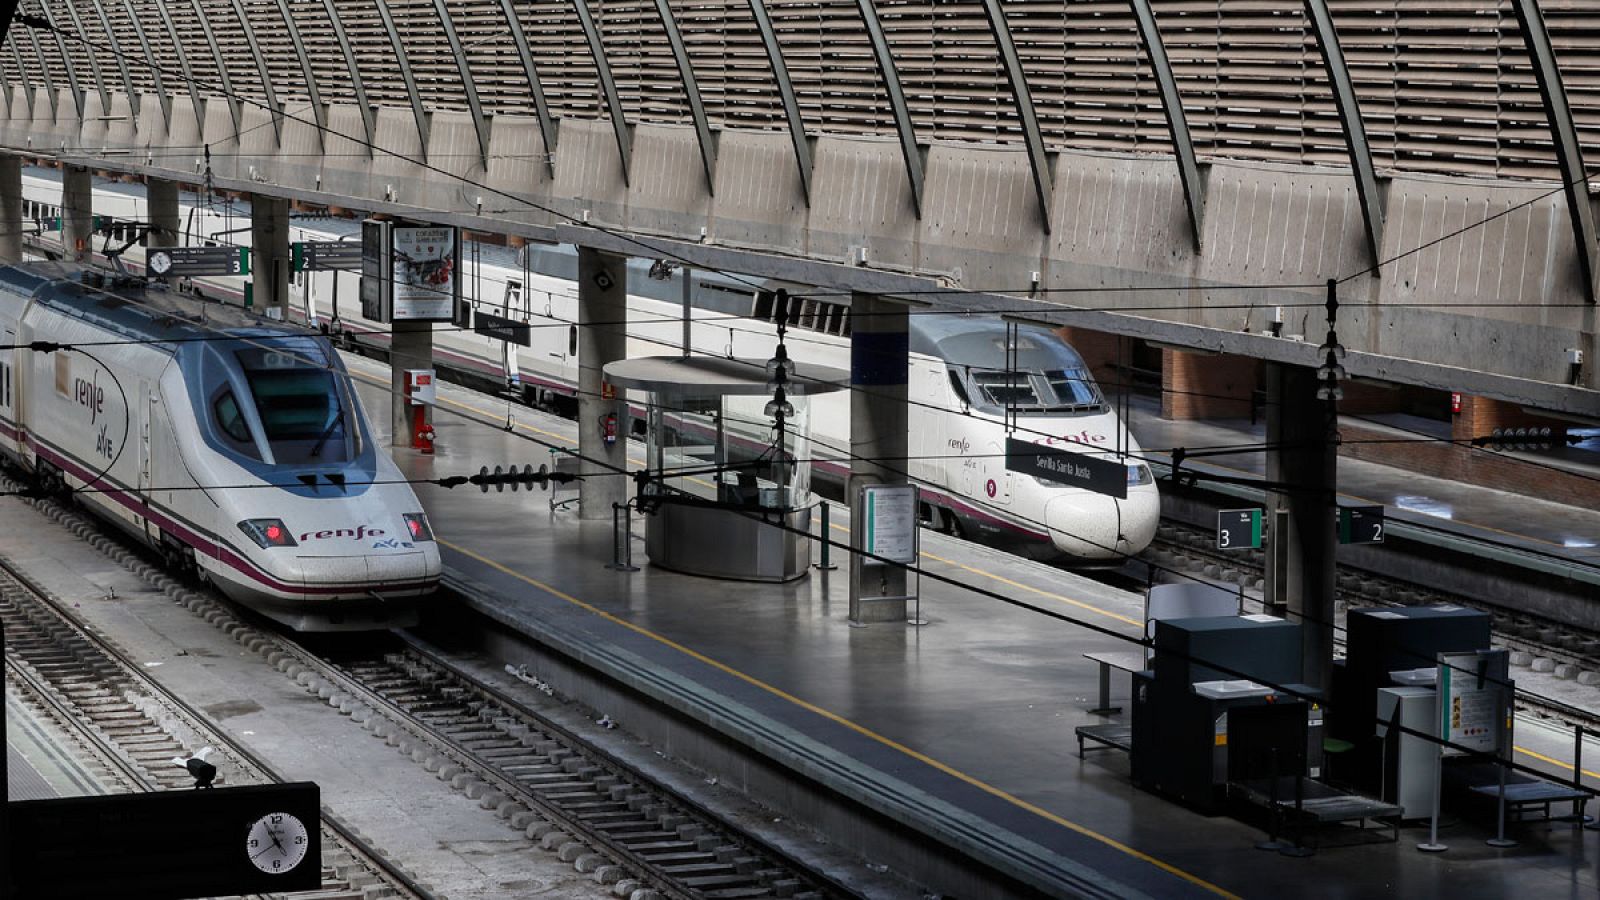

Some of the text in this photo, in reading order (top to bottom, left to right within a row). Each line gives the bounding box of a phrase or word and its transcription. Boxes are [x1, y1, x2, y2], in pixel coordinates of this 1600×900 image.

[233, 261, 240, 273] 3
[302, 257, 309, 268] 2
[76, 369, 104, 425] renfe
[96, 424, 112, 460] AVE
[948, 436, 970, 454] renfe
[1037, 455, 1091, 480] Sevilla Santa Justa
[300, 525, 385, 541] renfe
[1220, 530, 1230, 547] 3
[1372, 523, 1382, 541] 2
[373, 539, 415, 549] AVE
[271, 816, 283, 824] 12
[295, 836, 302, 844] 3
[273, 860, 280, 868] 6
